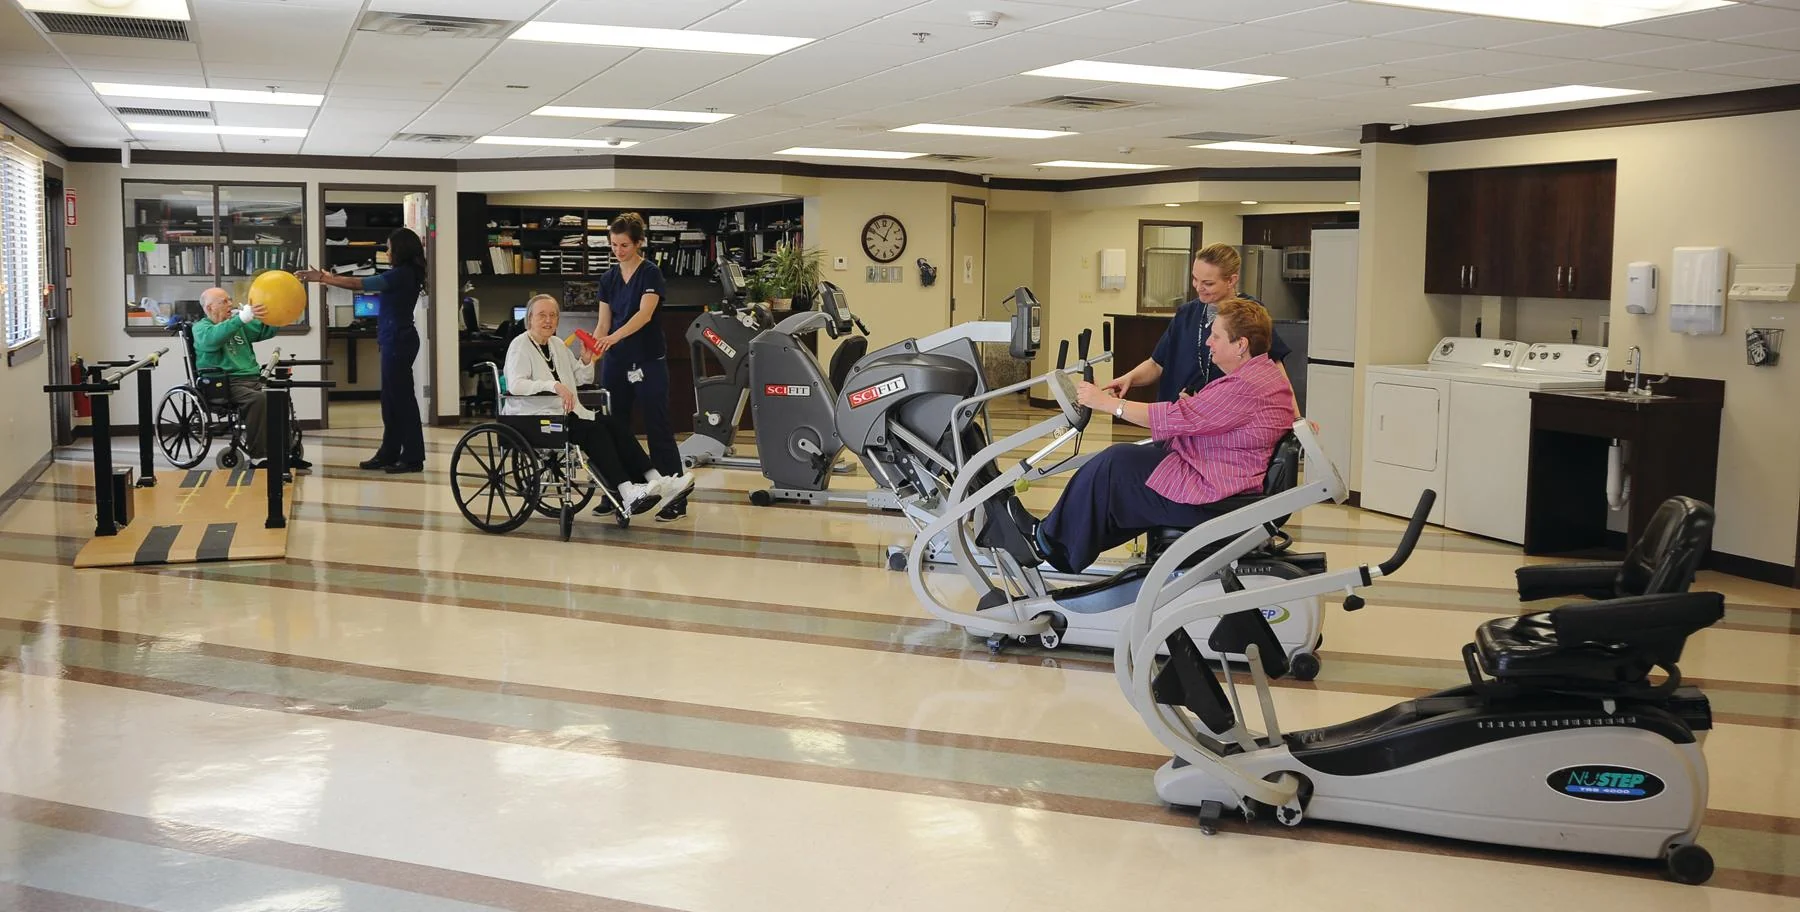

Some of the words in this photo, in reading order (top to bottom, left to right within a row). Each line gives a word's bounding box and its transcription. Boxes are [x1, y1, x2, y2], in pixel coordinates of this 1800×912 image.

[703, 328, 736, 357] SCIFIT
[767, 386, 809, 395] SCIFIT
[852, 379, 903, 404] SCIFIT
